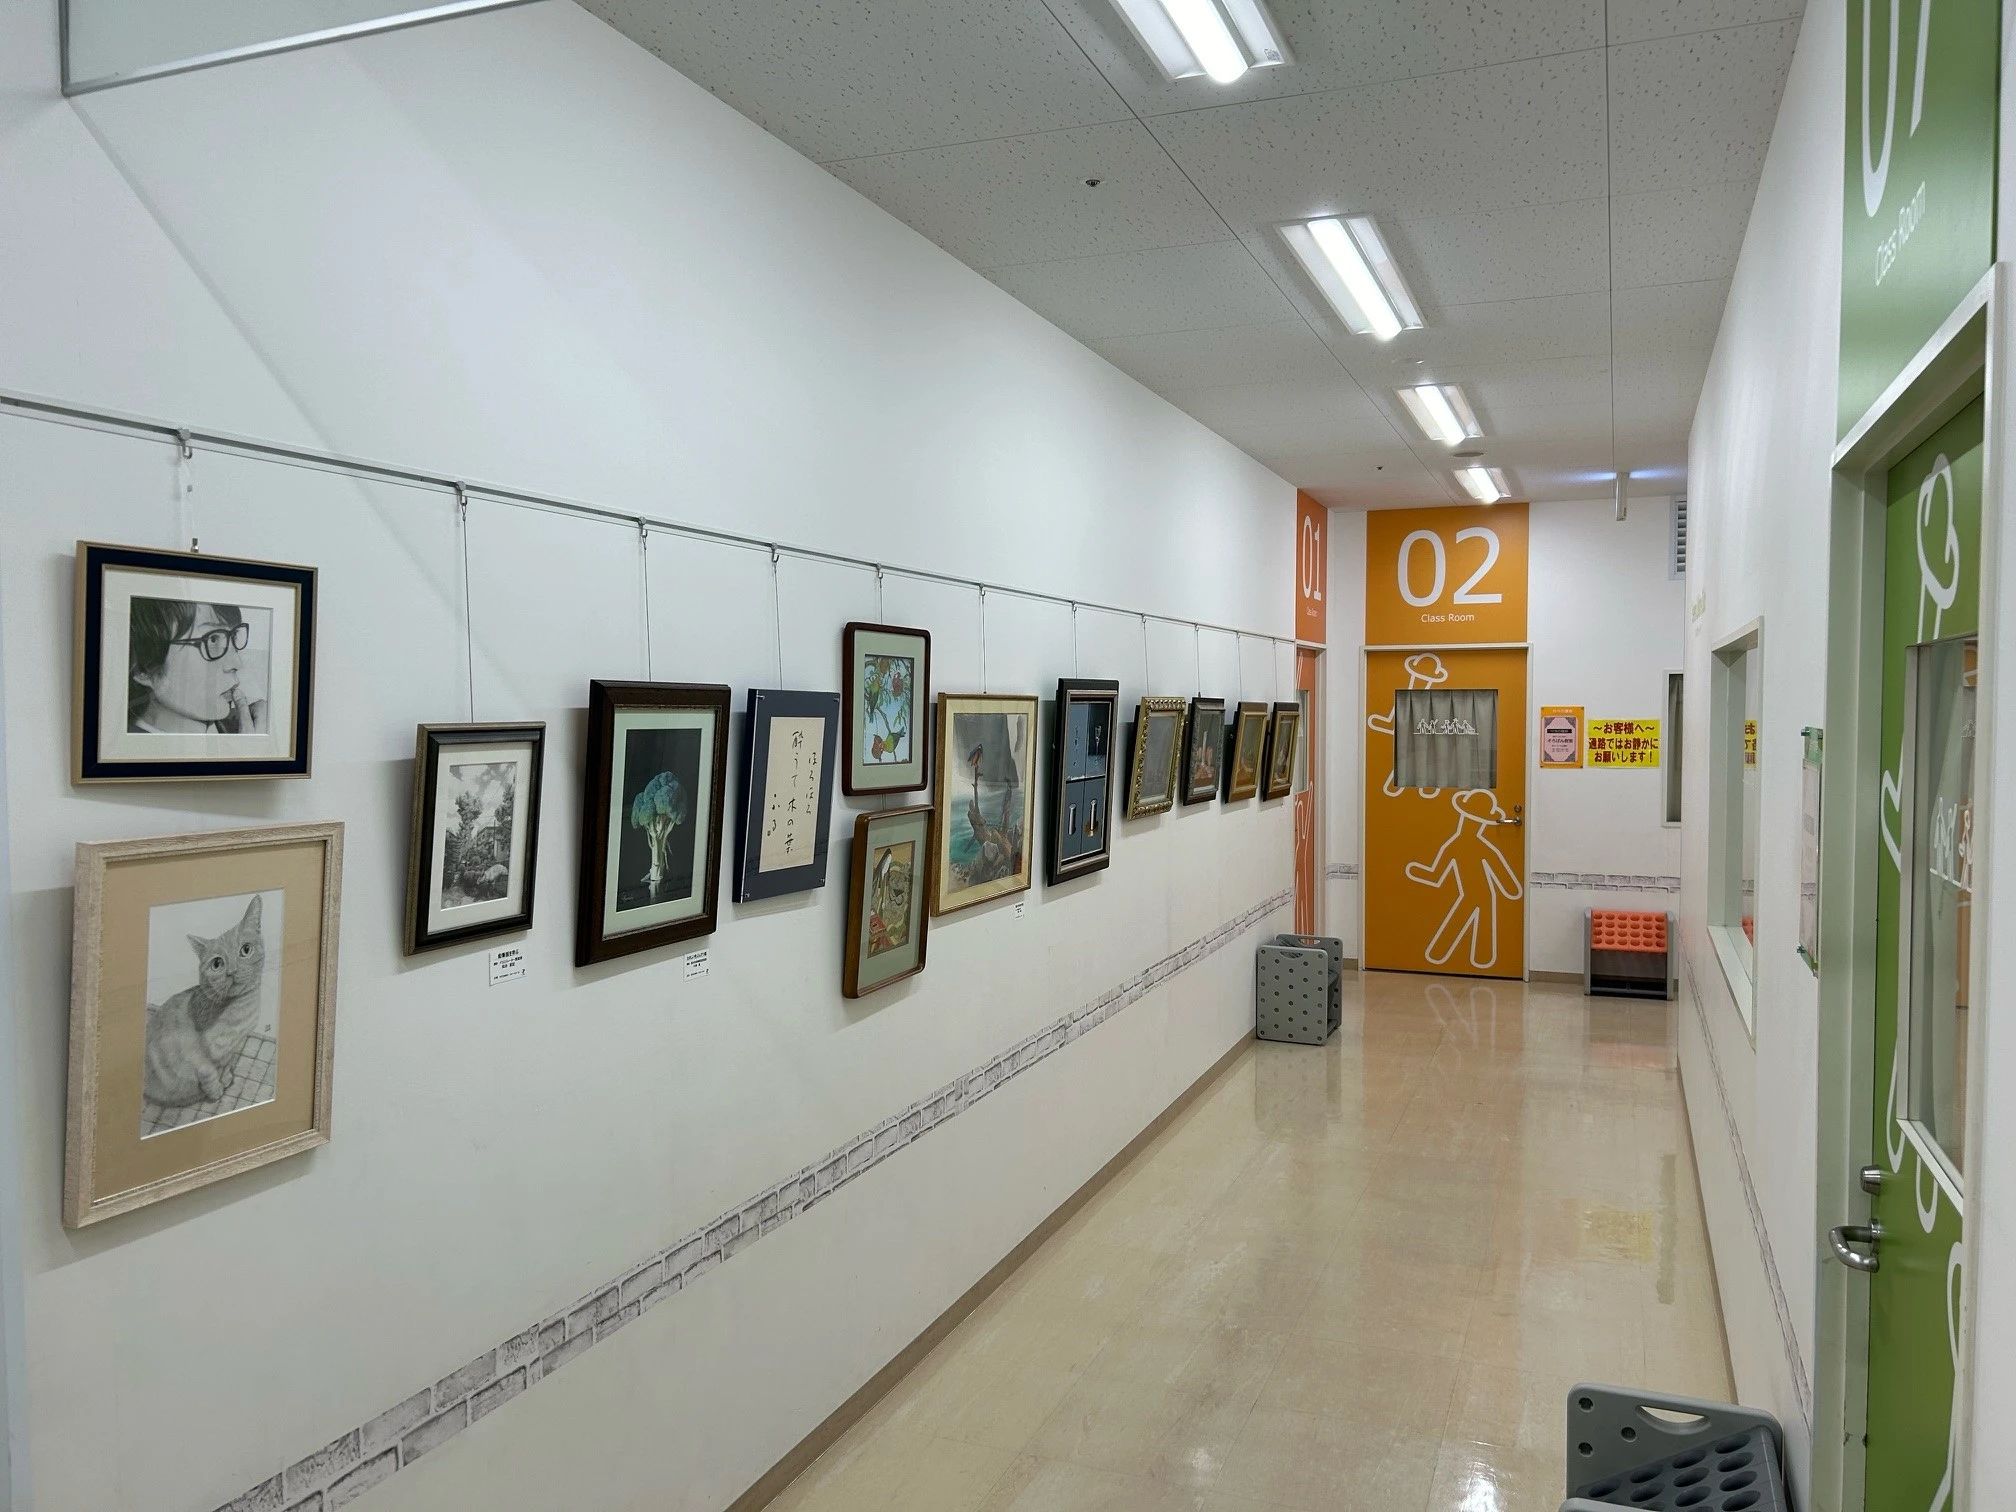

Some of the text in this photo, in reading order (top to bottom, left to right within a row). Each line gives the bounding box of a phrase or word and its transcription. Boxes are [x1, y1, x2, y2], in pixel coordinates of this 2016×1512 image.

[1302, 515, 1321, 601] 01
[1397, 526, 1503, 608] 02
[1420, 612, 1475, 624] Class Room
[1588, 737, 1659, 750] 通路ではお静かに
